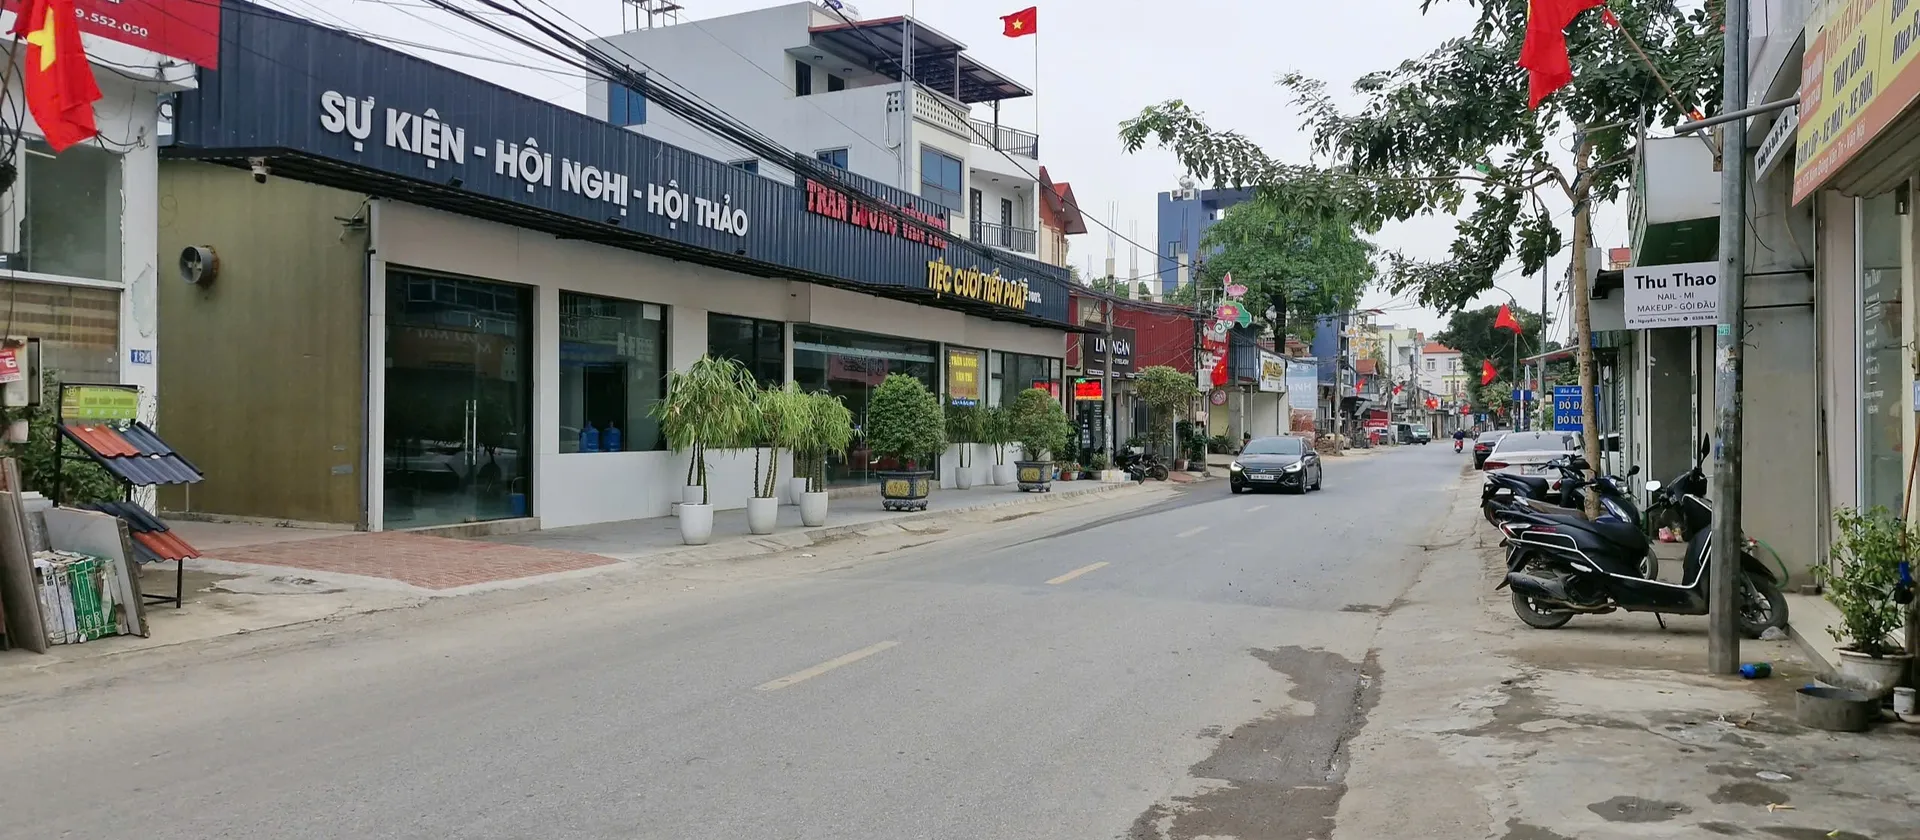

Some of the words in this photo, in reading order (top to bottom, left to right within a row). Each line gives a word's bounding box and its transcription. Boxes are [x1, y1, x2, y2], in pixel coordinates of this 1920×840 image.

[1833, 54, 1850, 99] THAY
[320, 90, 375, 152] SỰ
[386, 108, 465, 169] KIỆN
[495, 137, 552, 193] HỘI
[561, 158, 628, 216] NGHỊ
[648, 179, 689, 229] HỘI
[695, 194, 748, 237] THẢO
[928, 257, 952, 299] TIỆC
[954, 265, 981, 299] CƯỚI
[1634, 275, 1667, 289] Thu
[1672, 272, 1717, 288] Thao
[1657, 293, 1677, 301] NAIL
[1637, 303, 1673, 313] MAKEUP
[1679, 302, 1695, 311] GỘI
[1095, 337, 1106, 353] LIN
